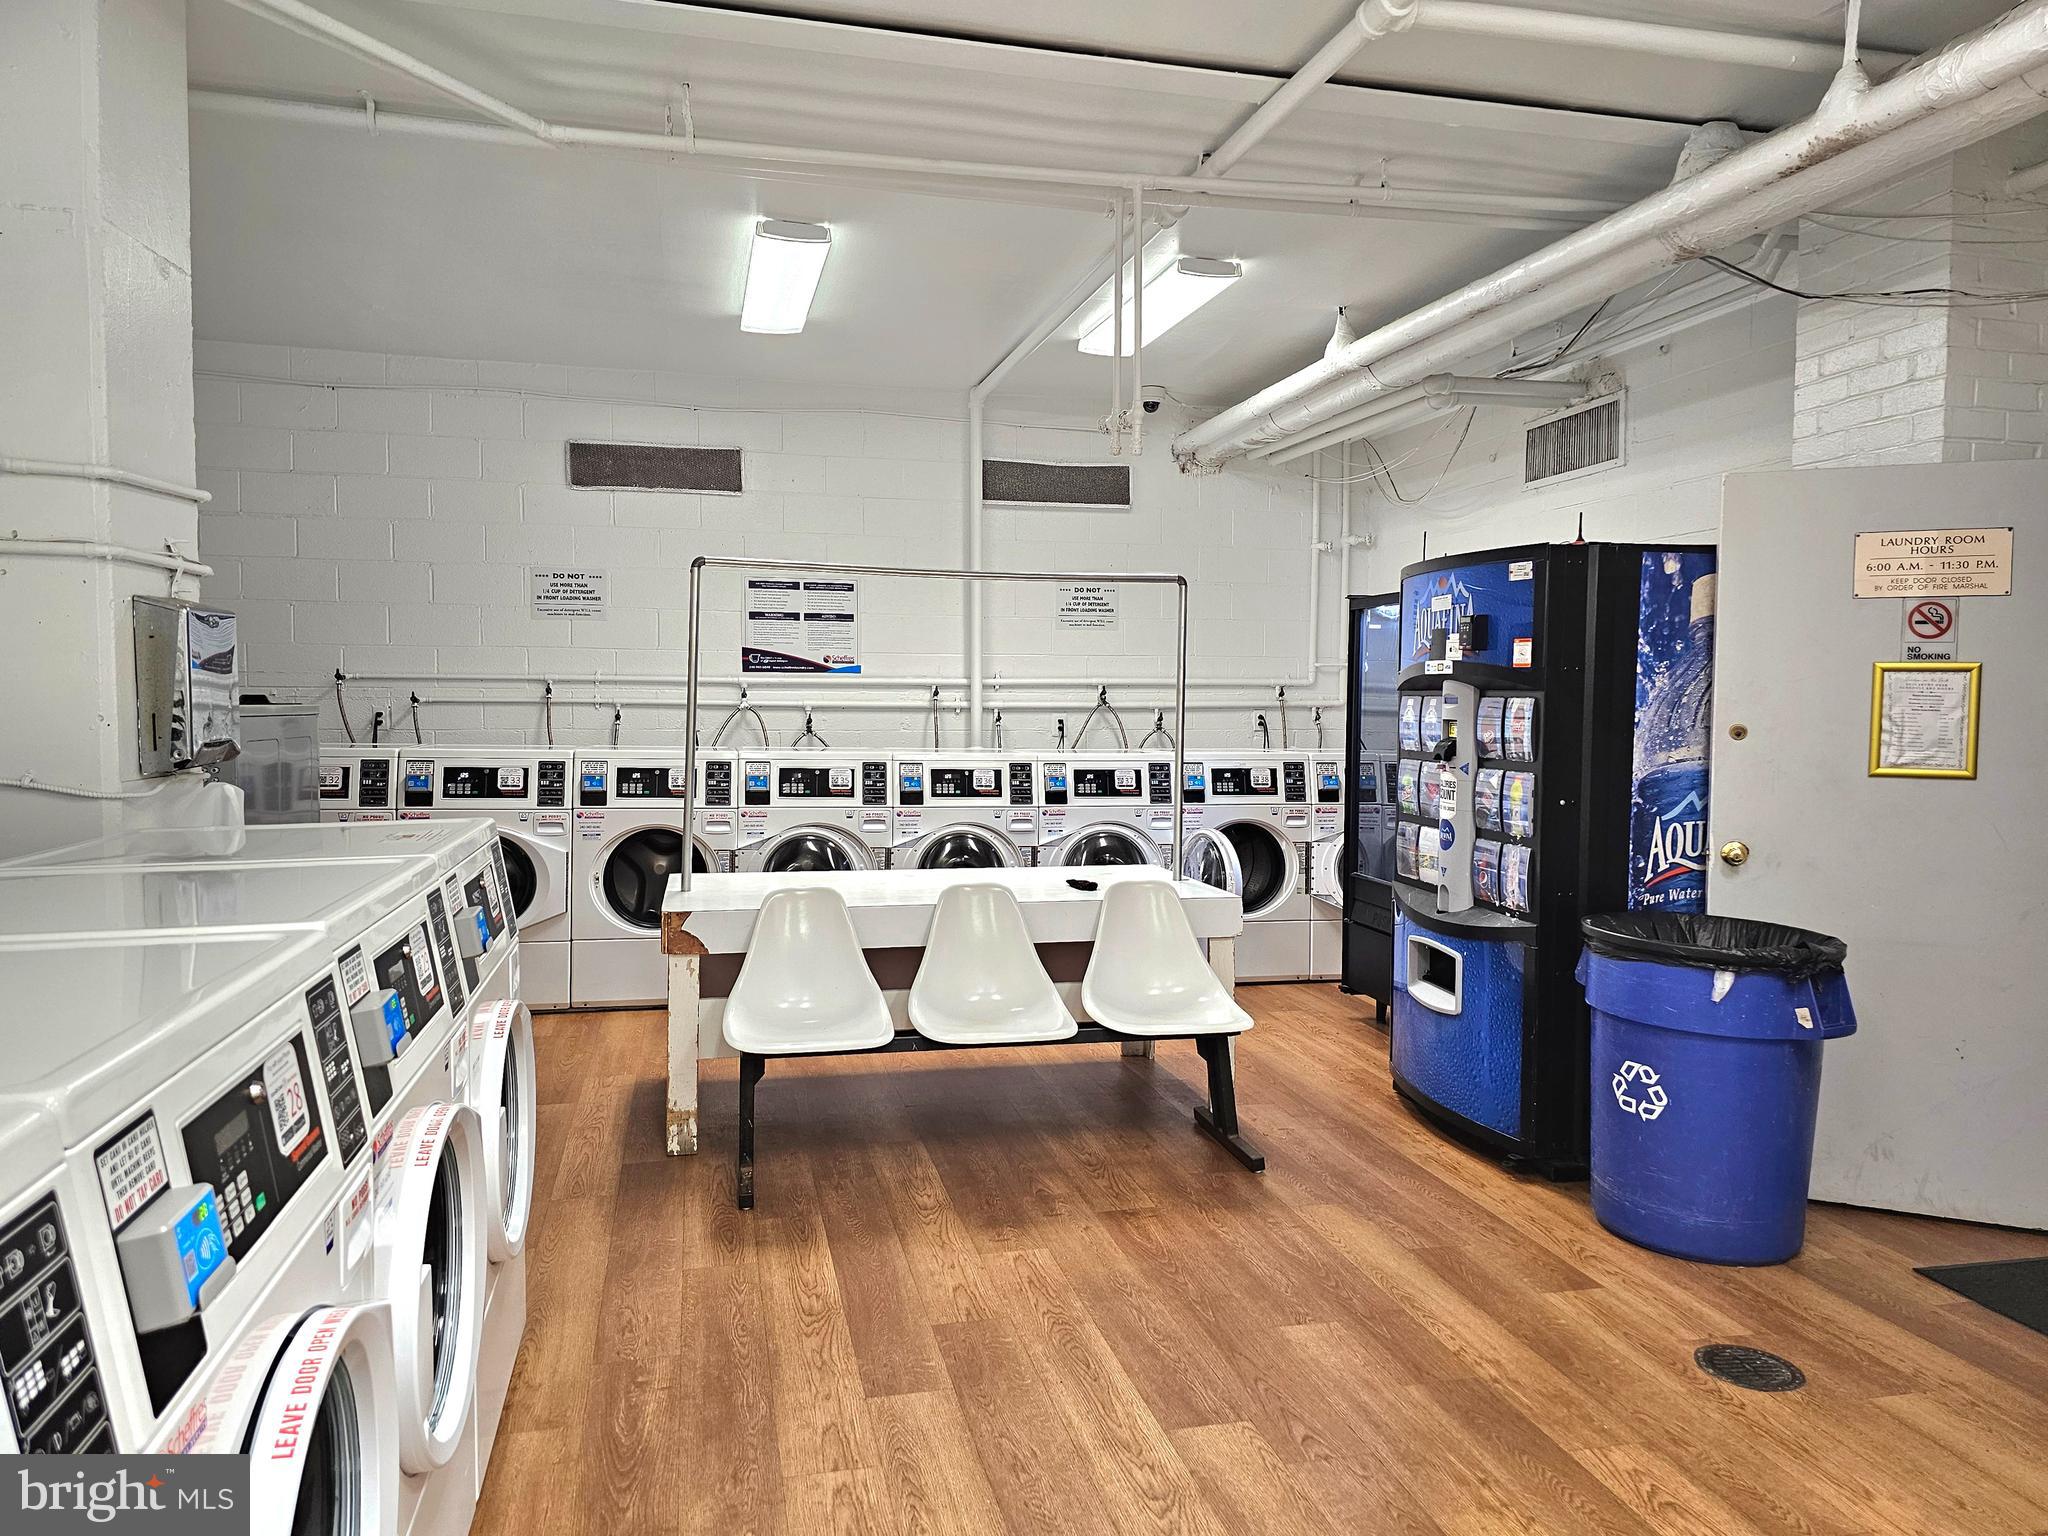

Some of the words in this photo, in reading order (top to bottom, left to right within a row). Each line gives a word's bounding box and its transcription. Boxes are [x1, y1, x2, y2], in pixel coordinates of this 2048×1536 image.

[1880, 536, 1938, 546] LAUNDRY
[1945, 535, 1986, 545] ROOM
[1910, 545, 1954, 554] HOURS
[1866, 563, 1891, 572] 6:00
[1896, 562, 1923, 571] A.M.
[1940, 560, 1970, 570] 11:30
[1976, 560, 1998, 569] P.M.
[1644, 816, 1709, 883] AQU
[1643, 894, 1664, 905] Pure
[1669, 888, 1703, 900] Water
[493, 1020, 506, 1038] LEAVE
[287, 1082, 302, 1117] 28
[100, 1156, 108, 1168] SET
[110, 1148, 121, 1162] CARD
[122, 1140, 127, 1150] IN
[128, 1131, 139, 1146] CARD
[110, 1162, 119, 1176] AND
[140, 1135, 152, 1151] CARD
[414, 1139, 435, 1167] LEAVE
[110, 1175, 123, 1190] UNTIL
[124, 1159, 142, 1178] MACHINE
[142, 1147, 155, 1163] BEEPS
[116, 1186, 128, 1200] THEN
[128, 1170, 145, 1190] REMOVE
[145, 1160, 156, 1175] CARD
[114, 1204, 124, 1223] DO
[124, 1194, 137, 1215] NOT
[137, 1182, 148, 1200] TAP
[148, 1169, 164, 1192] CARD
[272, 1402, 308, 1459] LEAVE
[291, 1357, 322, 1395] DOOR
[308, 1327, 334, 1352] OPEN
